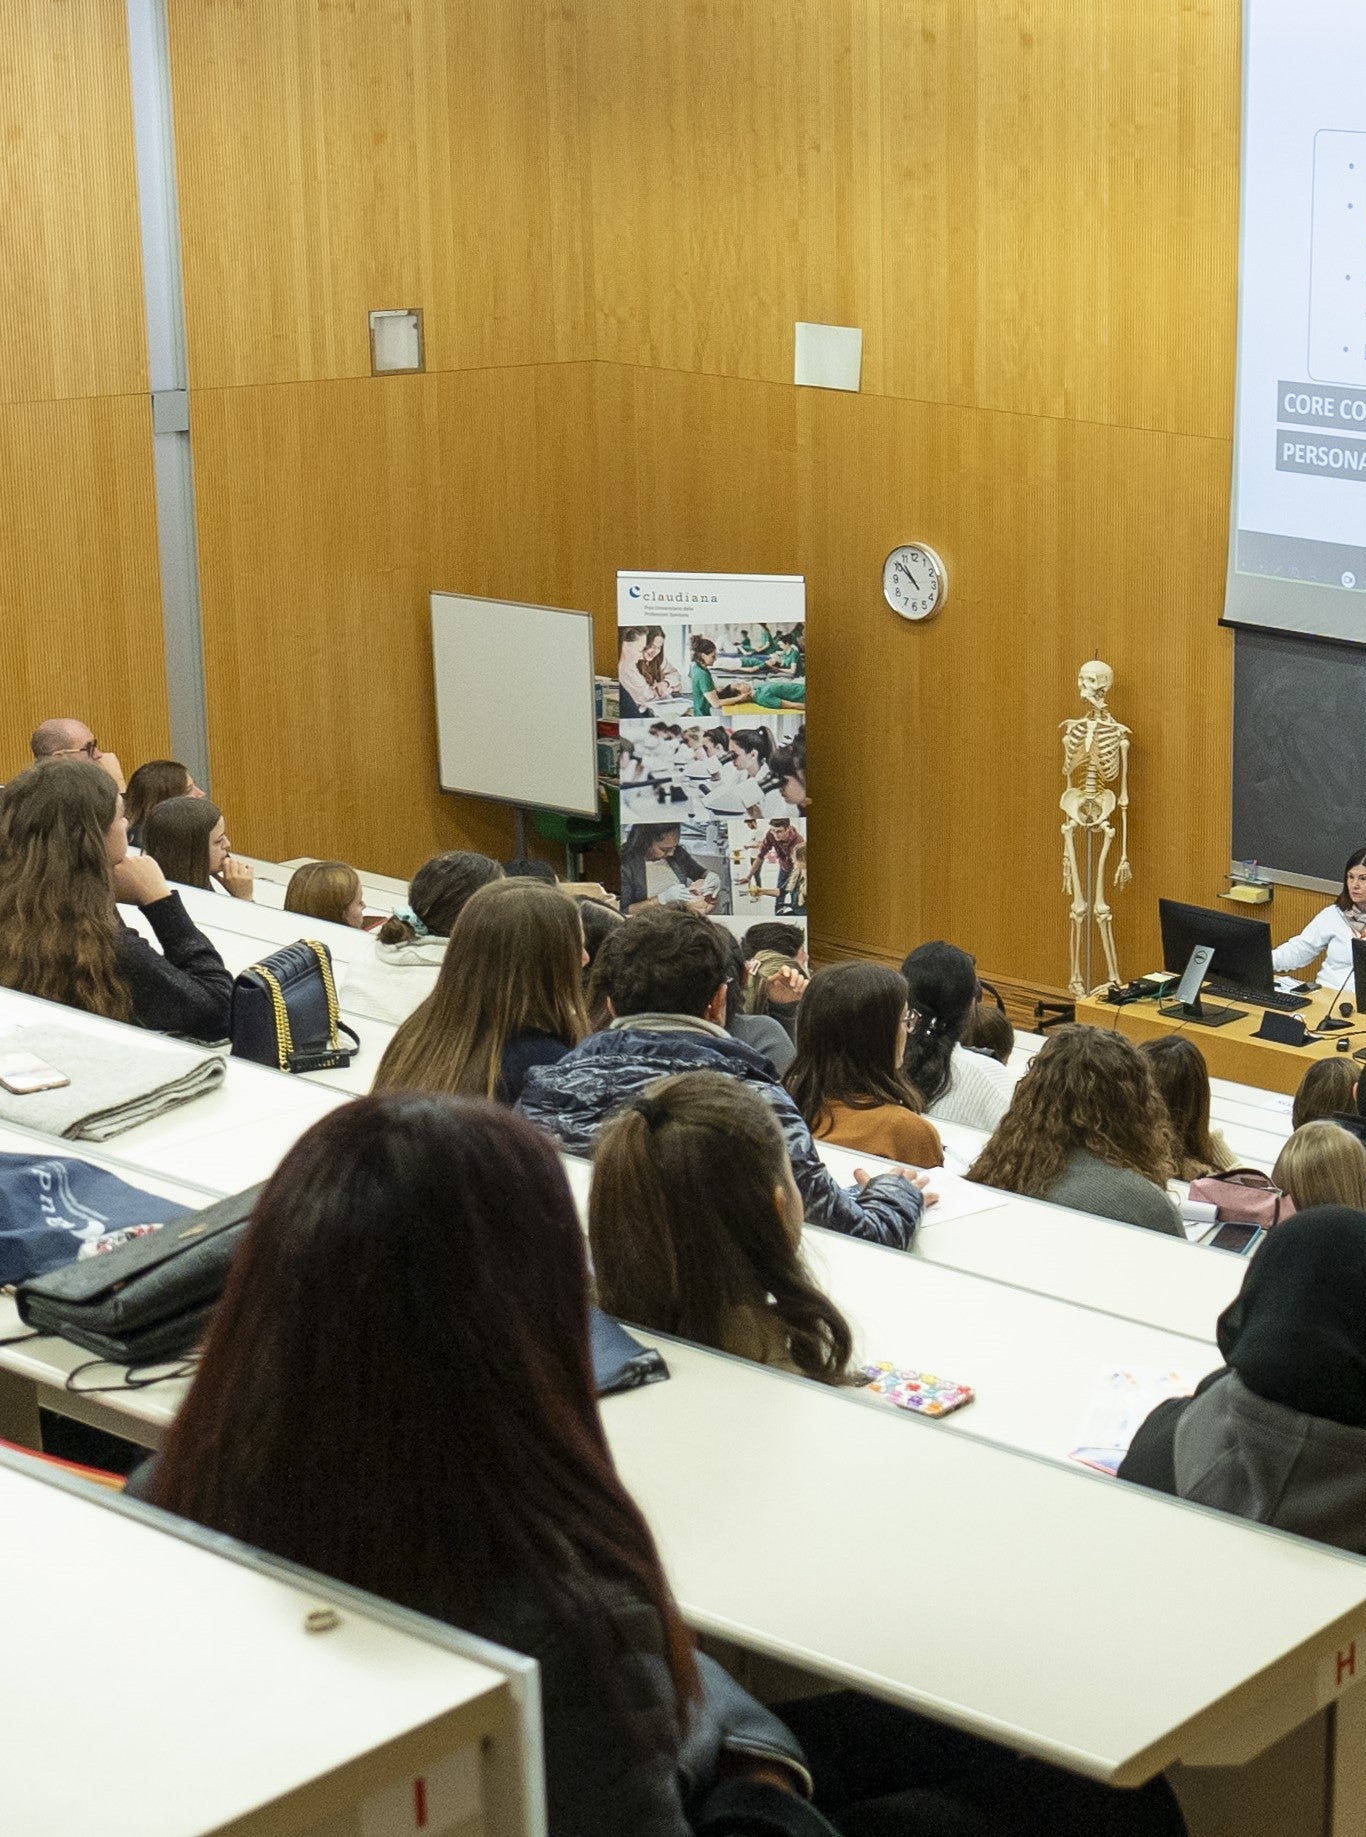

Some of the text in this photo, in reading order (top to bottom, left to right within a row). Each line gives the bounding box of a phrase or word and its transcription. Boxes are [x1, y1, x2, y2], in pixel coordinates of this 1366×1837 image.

[1284, 392, 1335, 418] CORE
[901, 554, 909, 564] 11
[910, 552, 919, 562] 12
[922, 558, 926, 567] 1
[928, 568, 935, 577] 2
[892, 574, 899, 584] 9
[931, 581, 936, 590] 3
[643, 591, 718, 603] claudiana
[895, 587, 901, 597] 8
[928, 593, 934, 601] 4
[903, 597, 909, 606] 7
[911, 602, 918, 611] 6
[921, 600, 927, 610] 5
[1336, 1641, 1356, 1685] H
[413, 1778, 427, 1828] I
